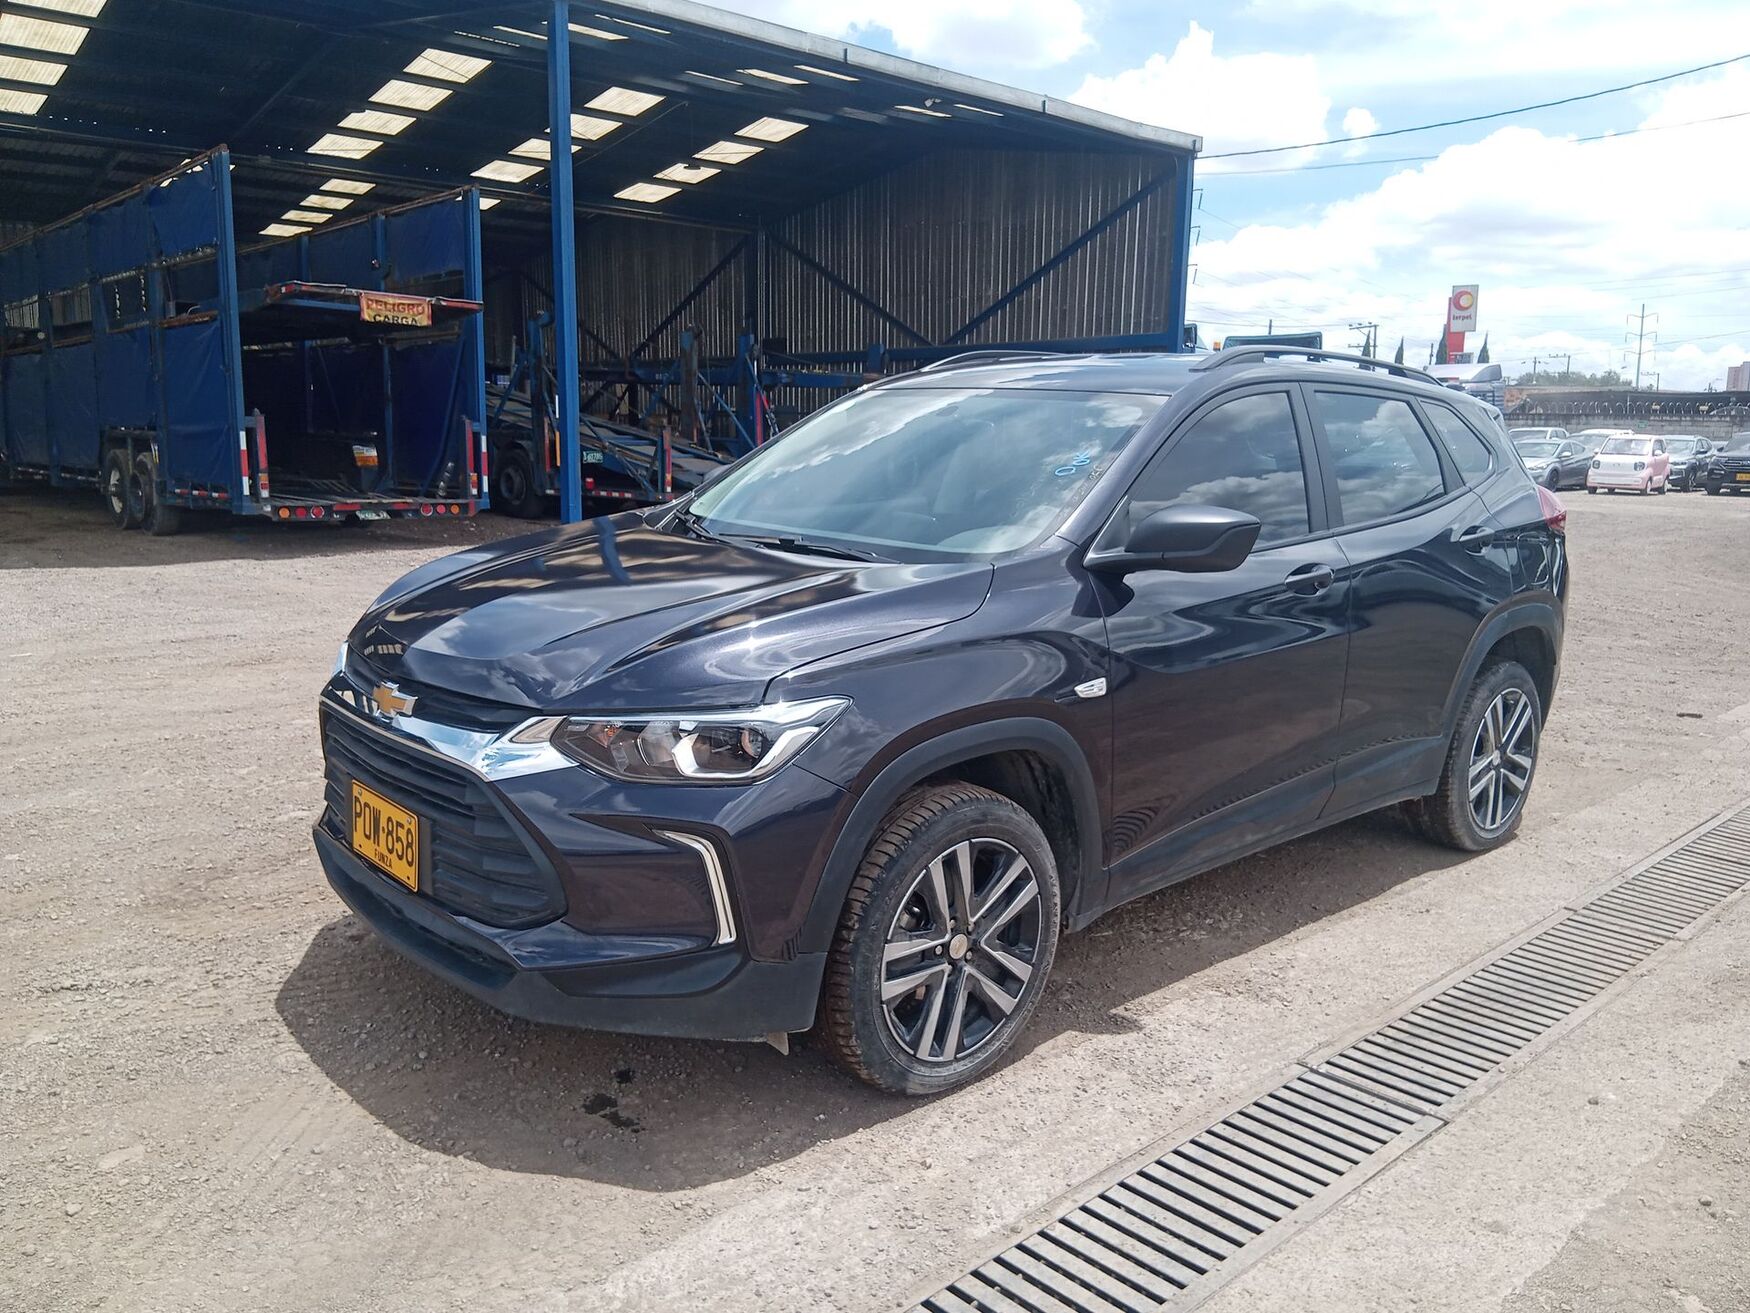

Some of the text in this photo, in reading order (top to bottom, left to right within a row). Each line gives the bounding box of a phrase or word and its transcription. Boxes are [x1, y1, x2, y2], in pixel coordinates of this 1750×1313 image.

[366, 298, 425, 315] PELIGRO
[373, 313, 419, 326] CARGA
[374, 848, 393, 869] FUNZA
